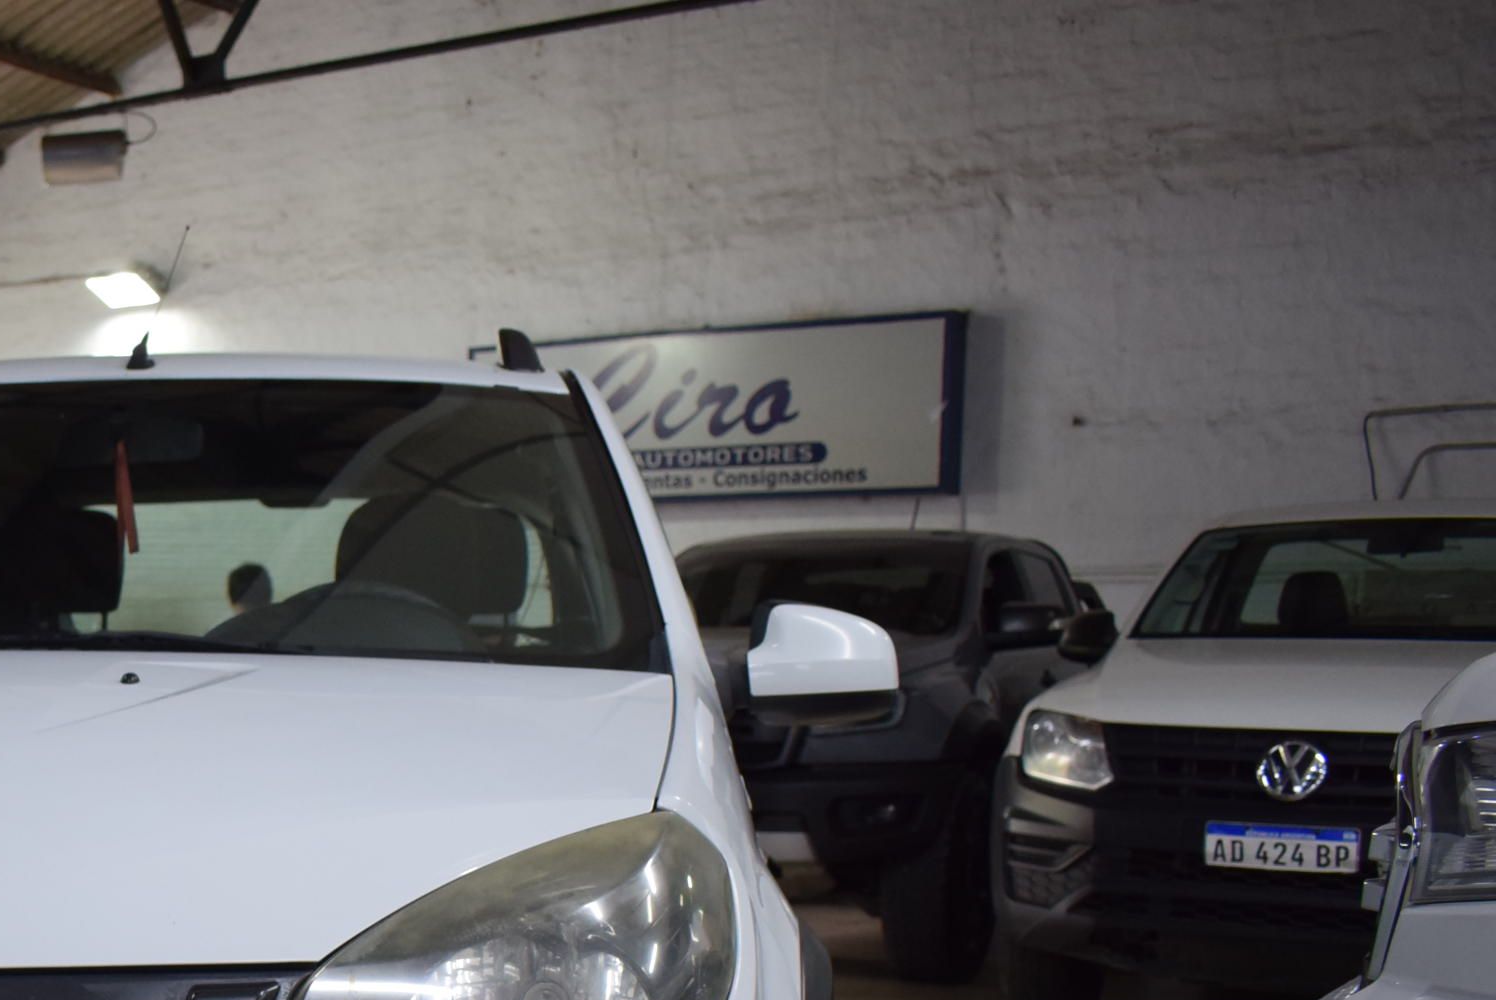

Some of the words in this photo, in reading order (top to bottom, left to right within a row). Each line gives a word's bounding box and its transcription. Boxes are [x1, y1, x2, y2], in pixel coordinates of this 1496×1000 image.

[593, 344, 798, 439] Ciro
[644, 474, 692, 489] entas
[713, 467, 868, 489] Consignaciones
[1213, 839, 1244, 862] AD
[1255, 841, 1304, 867] 424
[1315, 844, 1350, 869] BP
